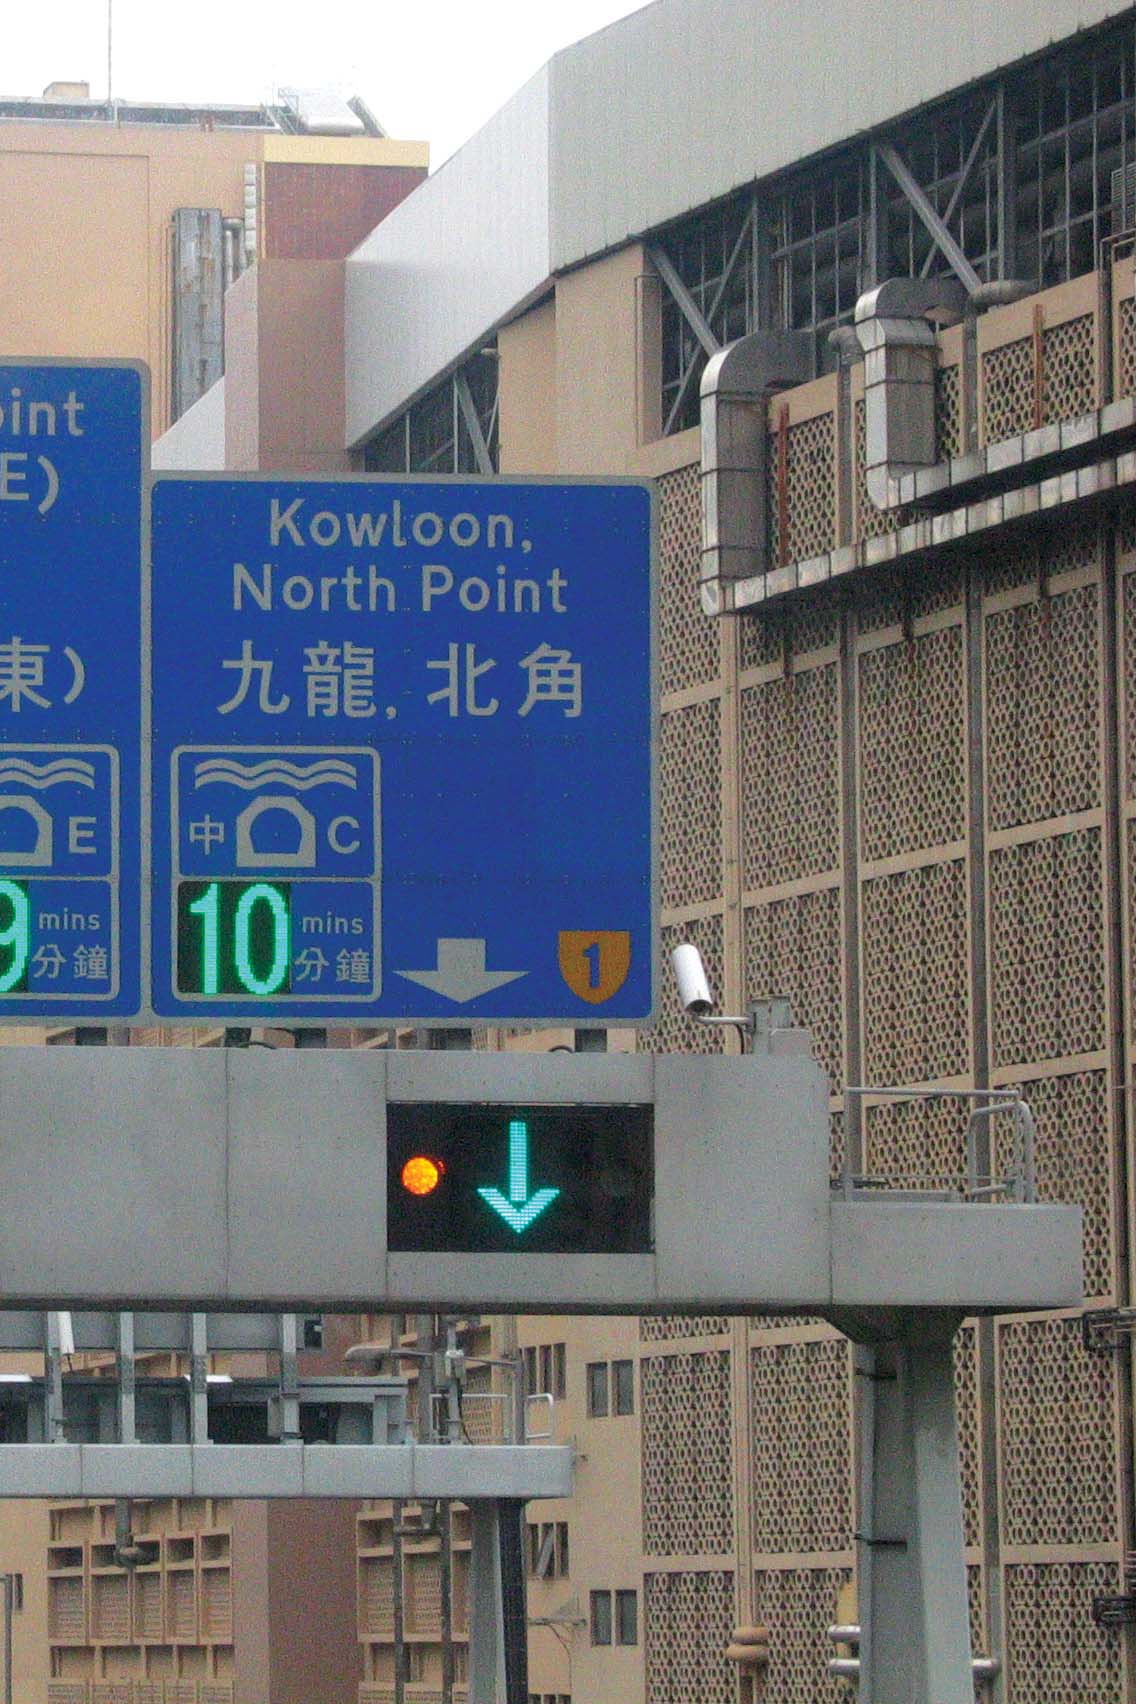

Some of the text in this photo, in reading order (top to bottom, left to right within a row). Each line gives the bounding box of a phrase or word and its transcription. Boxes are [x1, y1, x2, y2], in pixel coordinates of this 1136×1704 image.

[269, 500, 533, 552] Kowloon,
[232, 563, 568, 613] North Point
[217, 639, 584, 719] 九龍, 北角
[67, 816, 97, 855] E
[189, 814, 226, 854] 中
[327, 815, 360, 854] C
[39, 908, 101, 930] mins
[302, 911, 364, 934] mins
[190, 883, 289, 995] 10
[32, 943, 109, 980] 分鐘
[295, 947, 371, 983] 分鐘
[582, 943, 601, 989] 1
